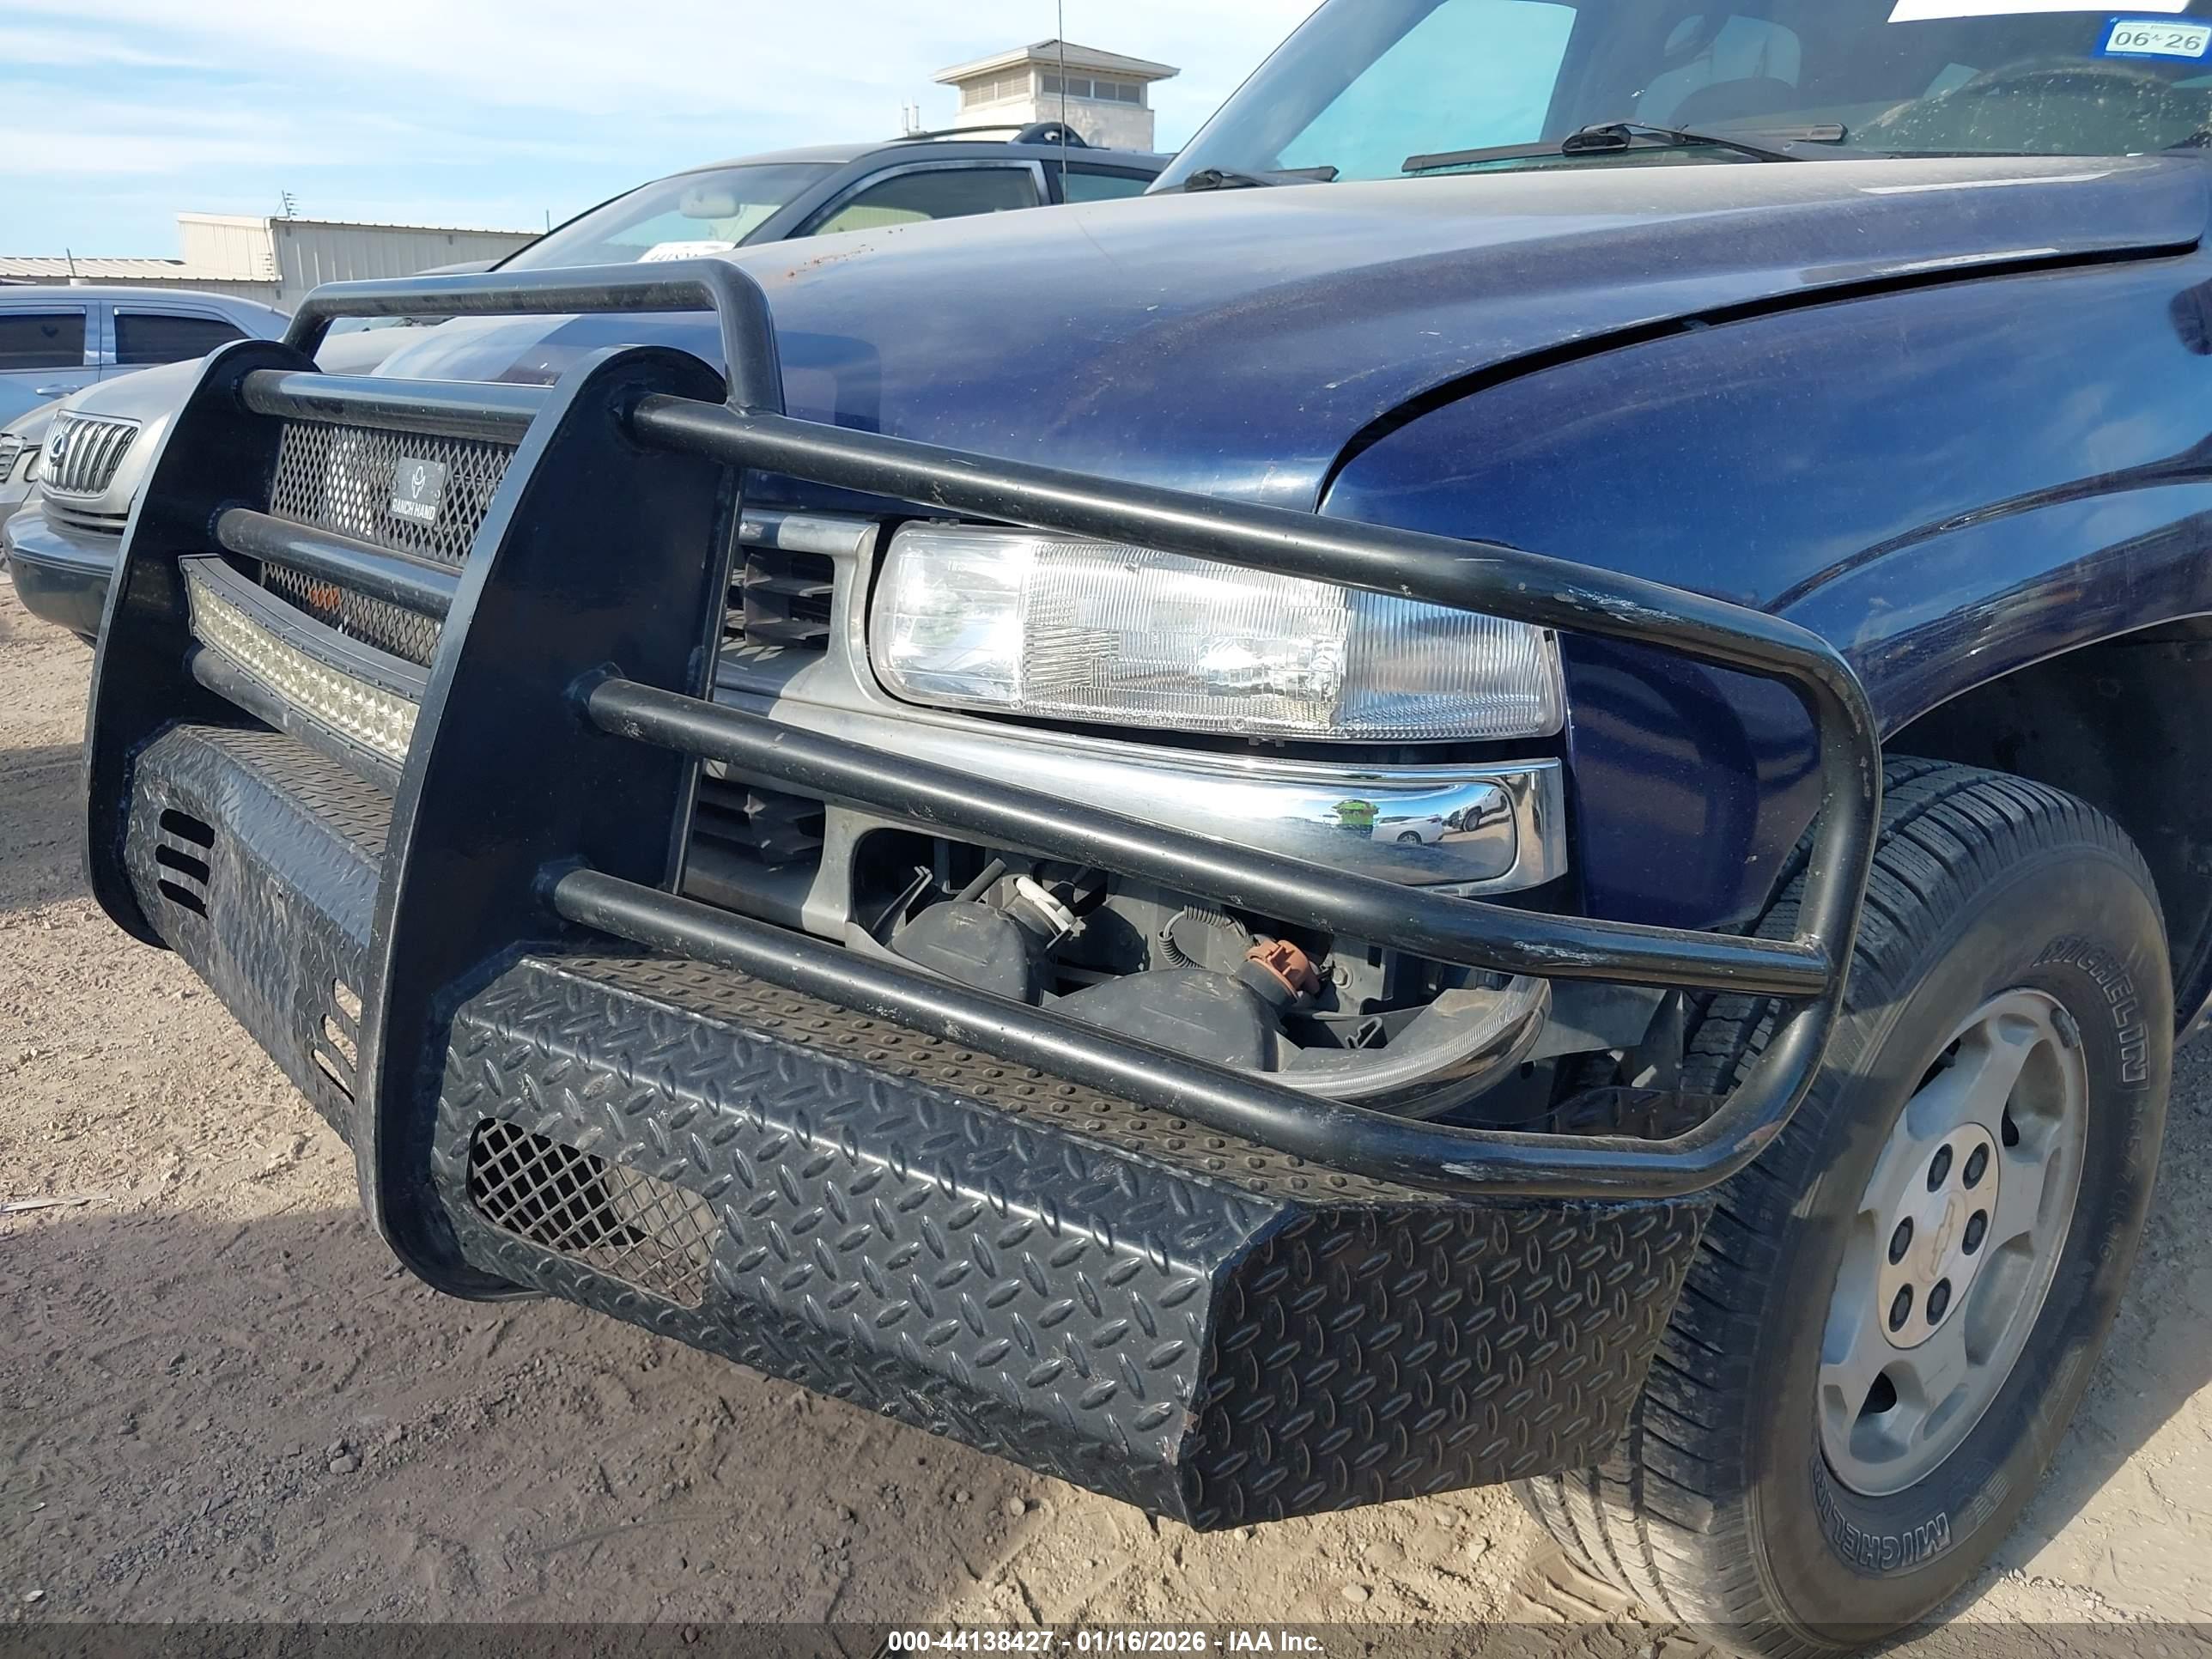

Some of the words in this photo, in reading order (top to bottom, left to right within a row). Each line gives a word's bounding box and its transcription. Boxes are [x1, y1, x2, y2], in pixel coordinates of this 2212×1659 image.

[2114, 31, 2152, 46] 06
[2163, 33, 2203, 51] 26
[392, 498, 414, 515] RANCH
[414, 502, 435, 520] HAND
[2030, 933, 2148, 1083] MICHELIN
